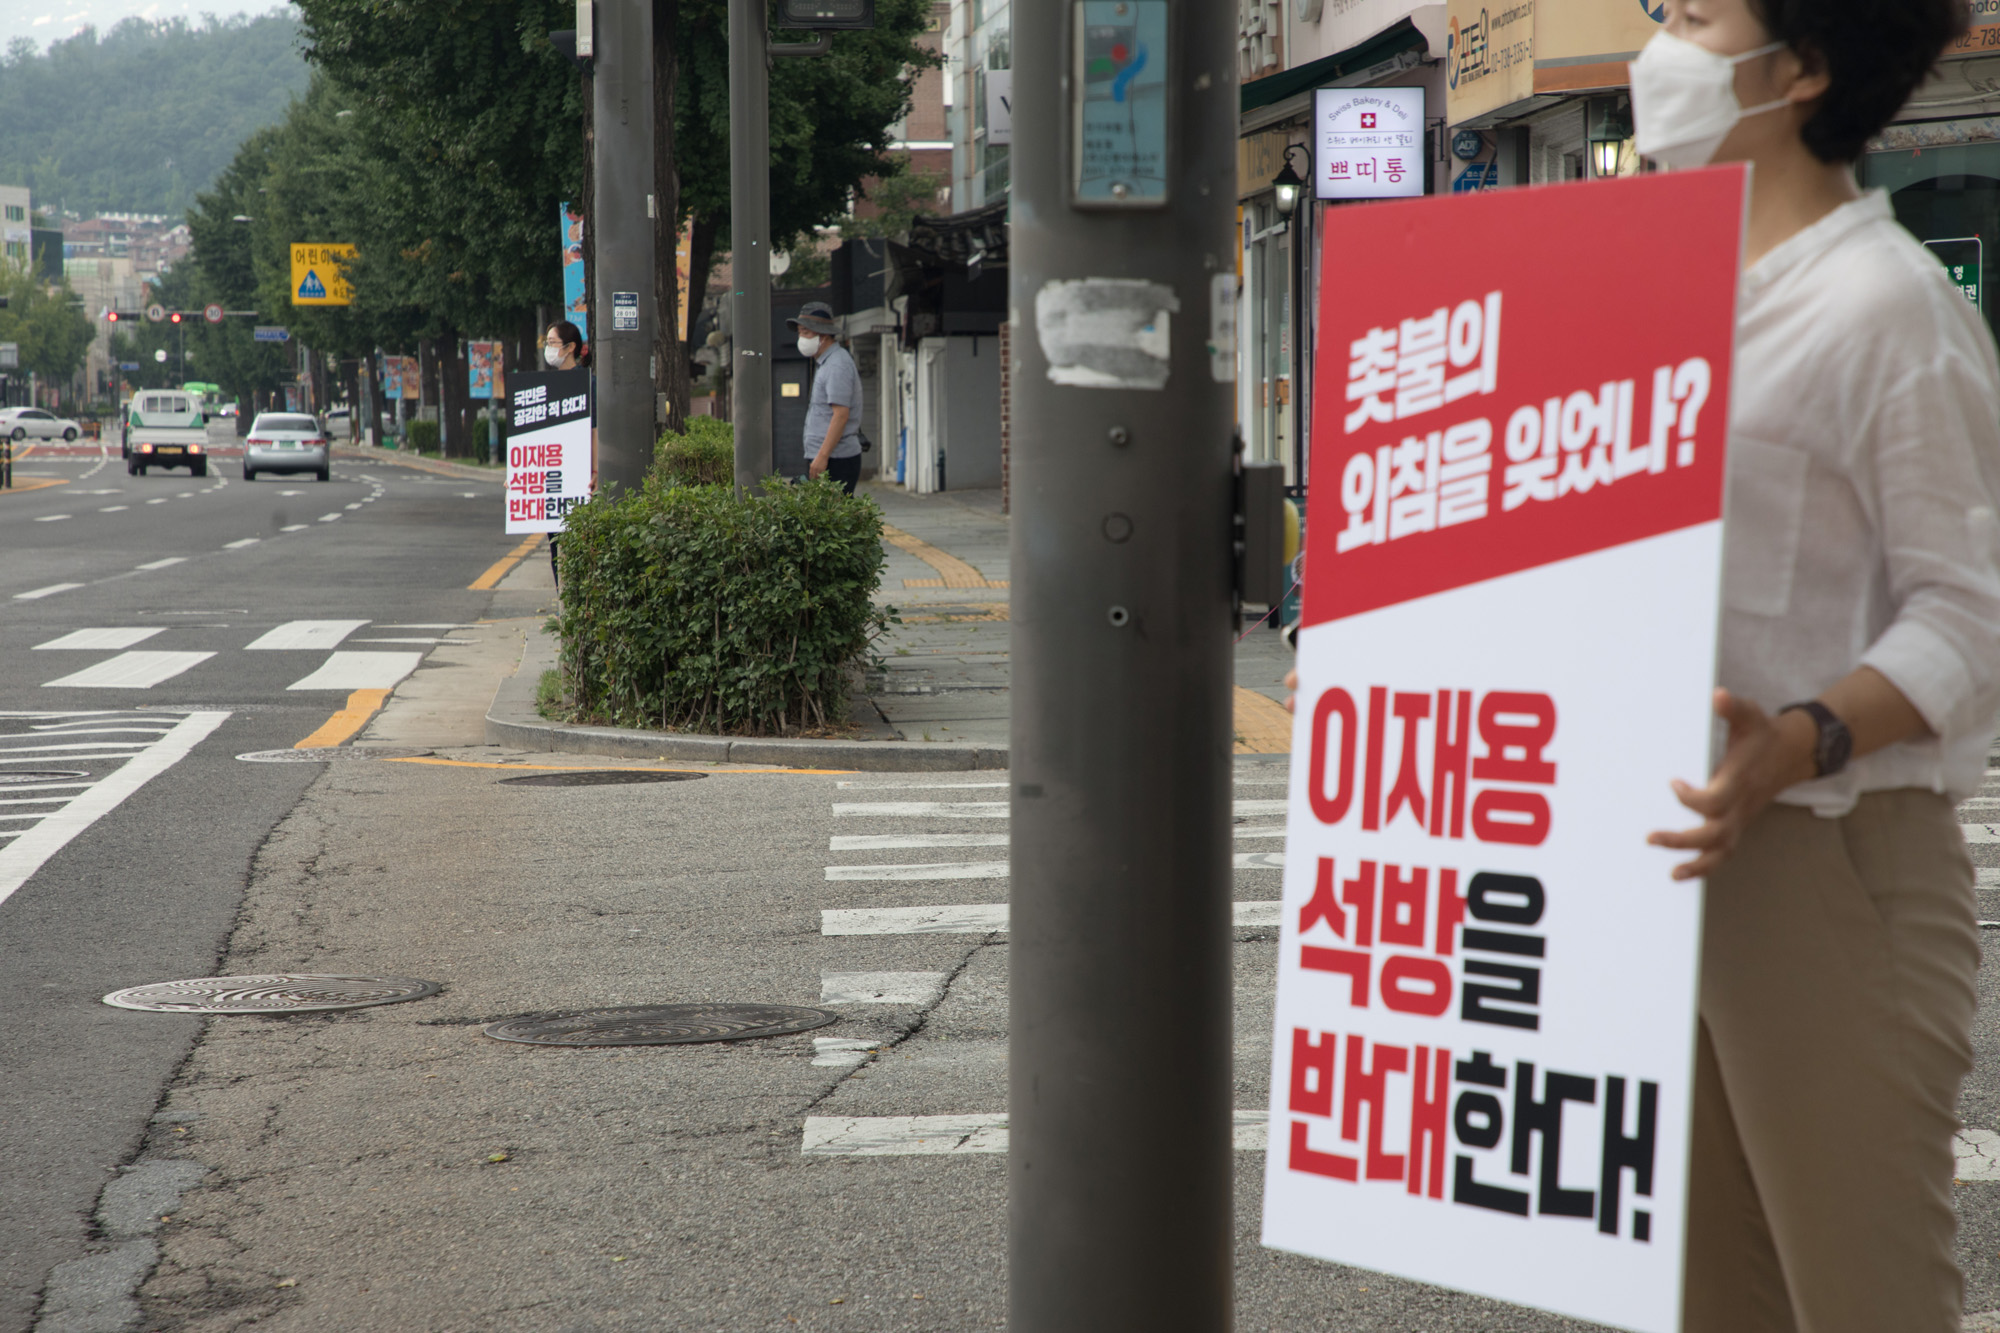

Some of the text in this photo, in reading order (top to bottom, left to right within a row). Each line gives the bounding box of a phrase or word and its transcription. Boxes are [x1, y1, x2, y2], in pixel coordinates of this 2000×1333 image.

[1461, 8, 1490, 76] 포토윈
[1328, 96, 1409, 121] Swiss Bakery & Deli
[1327, 136, 1347, 144] 스위스
[1350, 136, 1380, 144] 베이커리
[1395, 133, 1413, 146] 델리
[1458, 140, 1478, 150] ADT
[1328, 157, 1407, 183] 쁘띠통
[1344, 290, 1503, 434] 촛불의
[514, 385, 547, 407] 국민은
[514, 393, 587, 427] 공감한 적 없다!
[510, 444, 563, 468] 이재용
[1336, 357, 1712, 554] 외침을 잊었나?
[510, 470, 563, 495] 석방을
[1308, 685, 1557, 846] 이재용
[1297, 856, 1547, 1032] 석방을
[1288, 1027, 1659, 1243] 반대한다!
